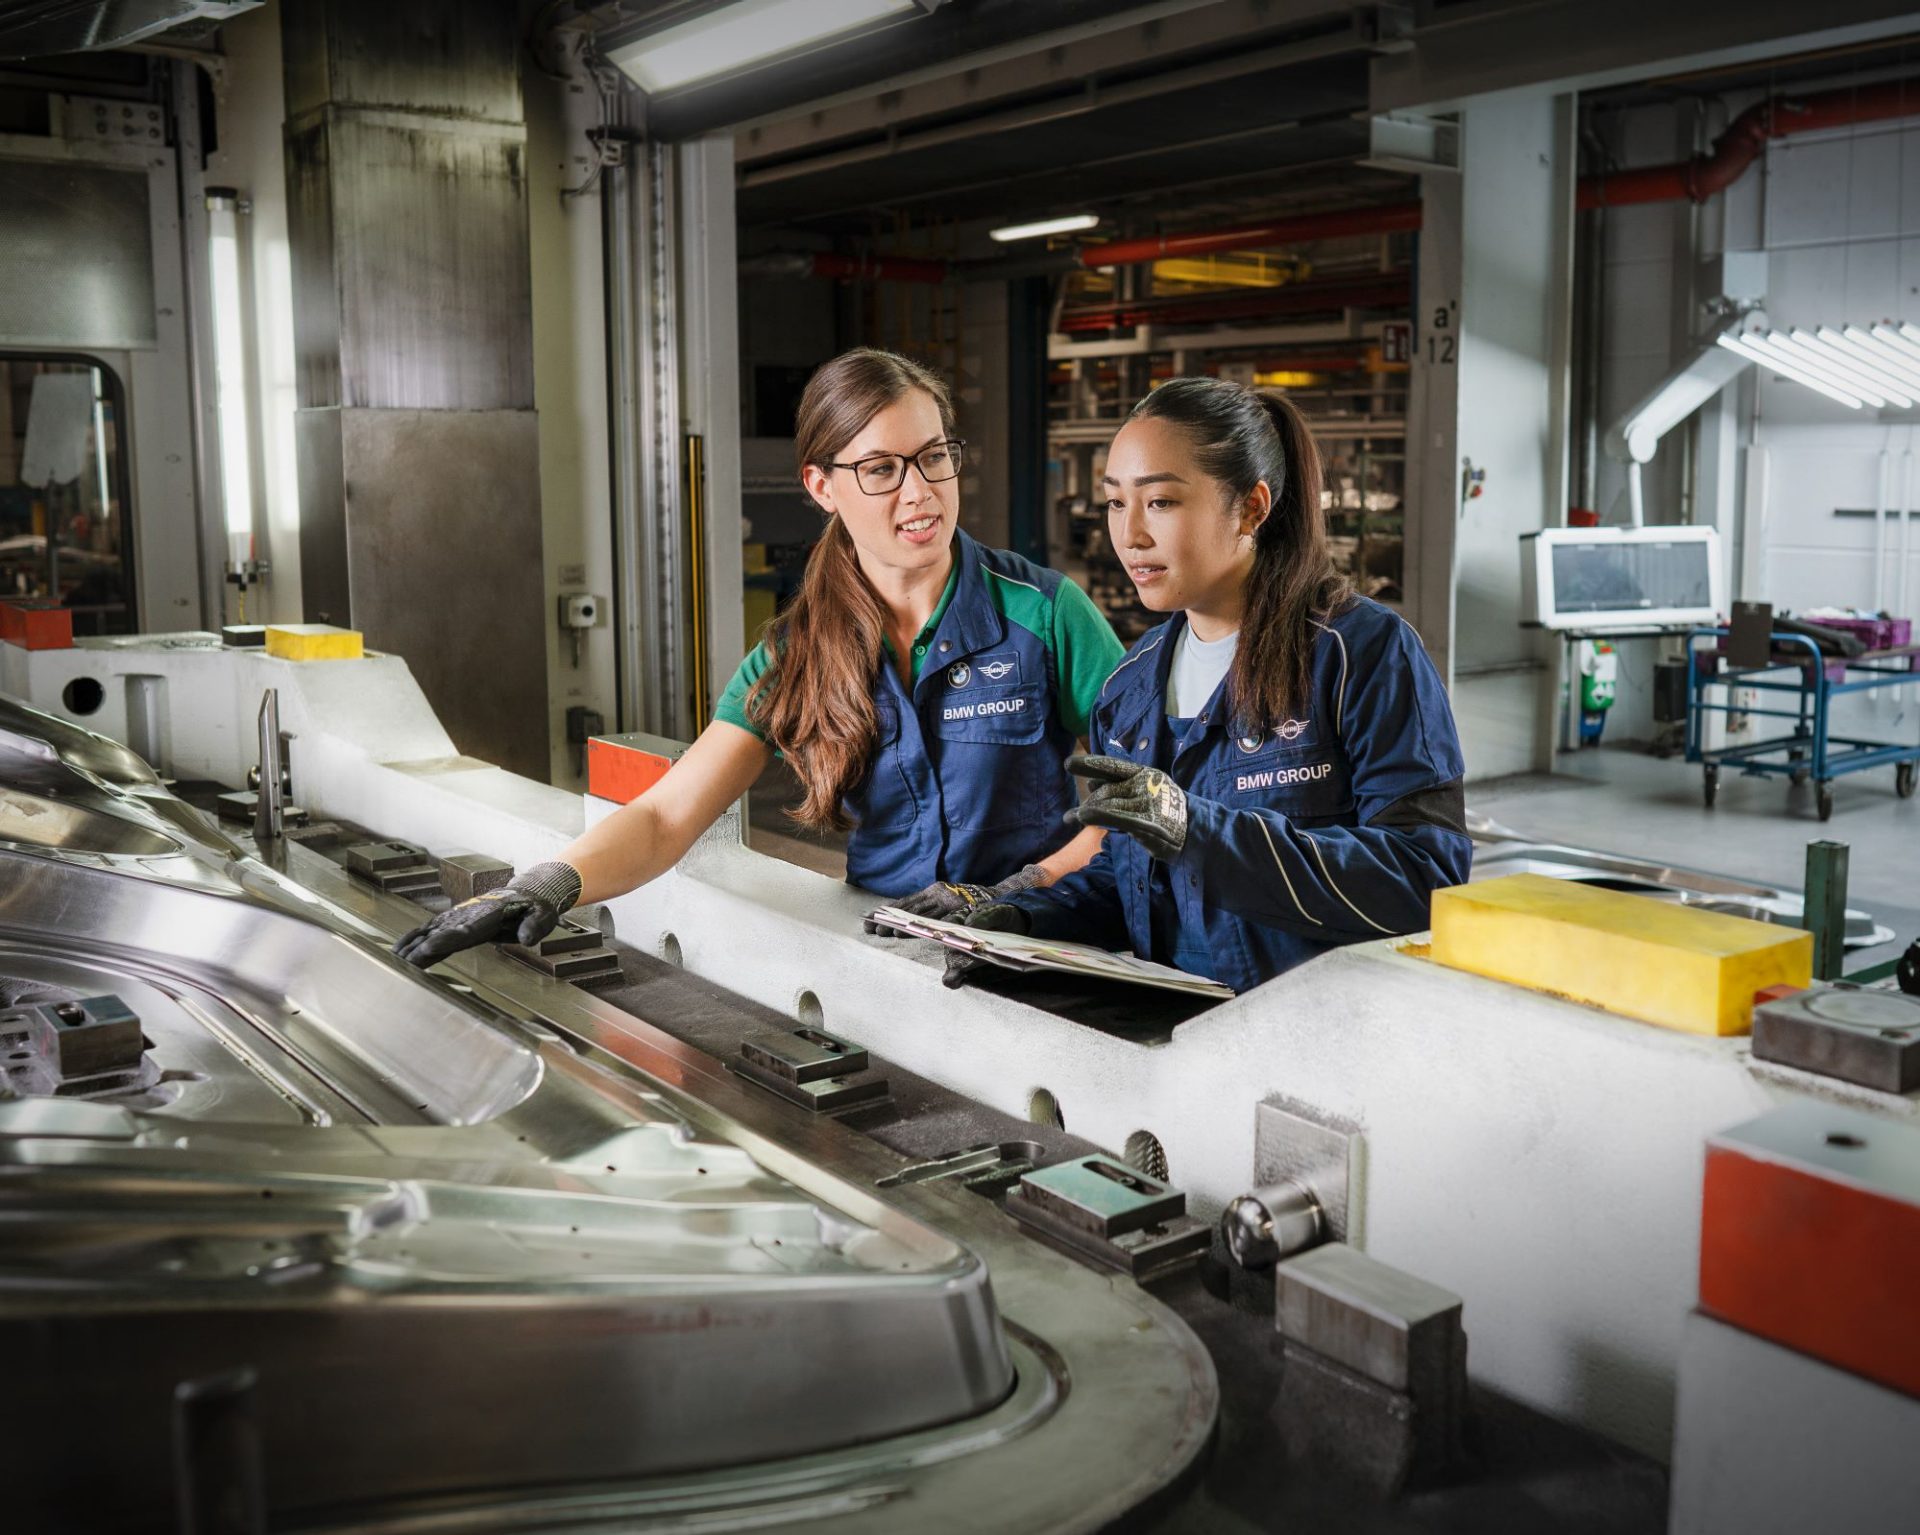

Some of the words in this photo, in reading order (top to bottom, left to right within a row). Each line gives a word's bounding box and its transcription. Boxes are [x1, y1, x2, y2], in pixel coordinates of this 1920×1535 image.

[1428, 336, 1454, 365] 12
[943, 705, 975, 720] BMW
[977, 699, 1024, 715] GROUP
[1237, 772, 1273, 790] BMW
[1276, 763, 1332, 784] GROUP
